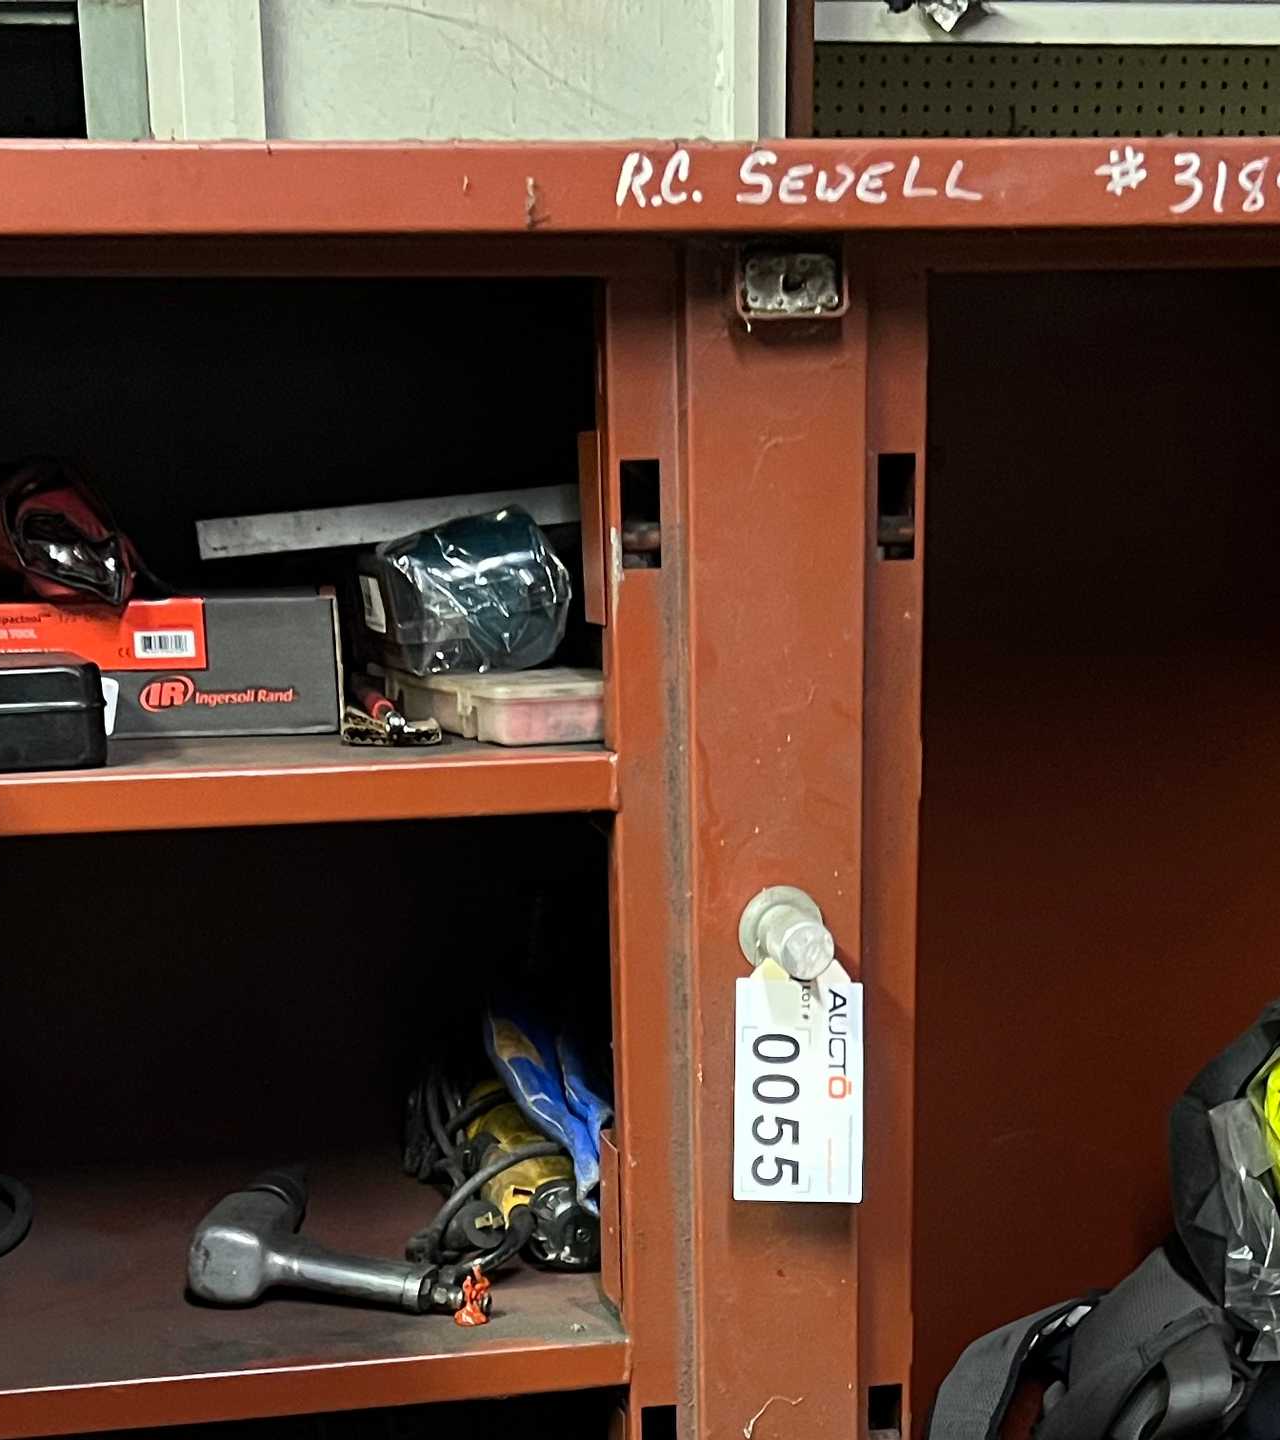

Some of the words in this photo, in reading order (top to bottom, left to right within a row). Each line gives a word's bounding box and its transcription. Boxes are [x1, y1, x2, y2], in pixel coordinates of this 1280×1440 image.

[613, 149, 703, 209] R.C.
[195, 689, 255, 708] Ingersoll
[257, 687, 295, 703] Rand
[750, 1032, 801, 1188] 0055
